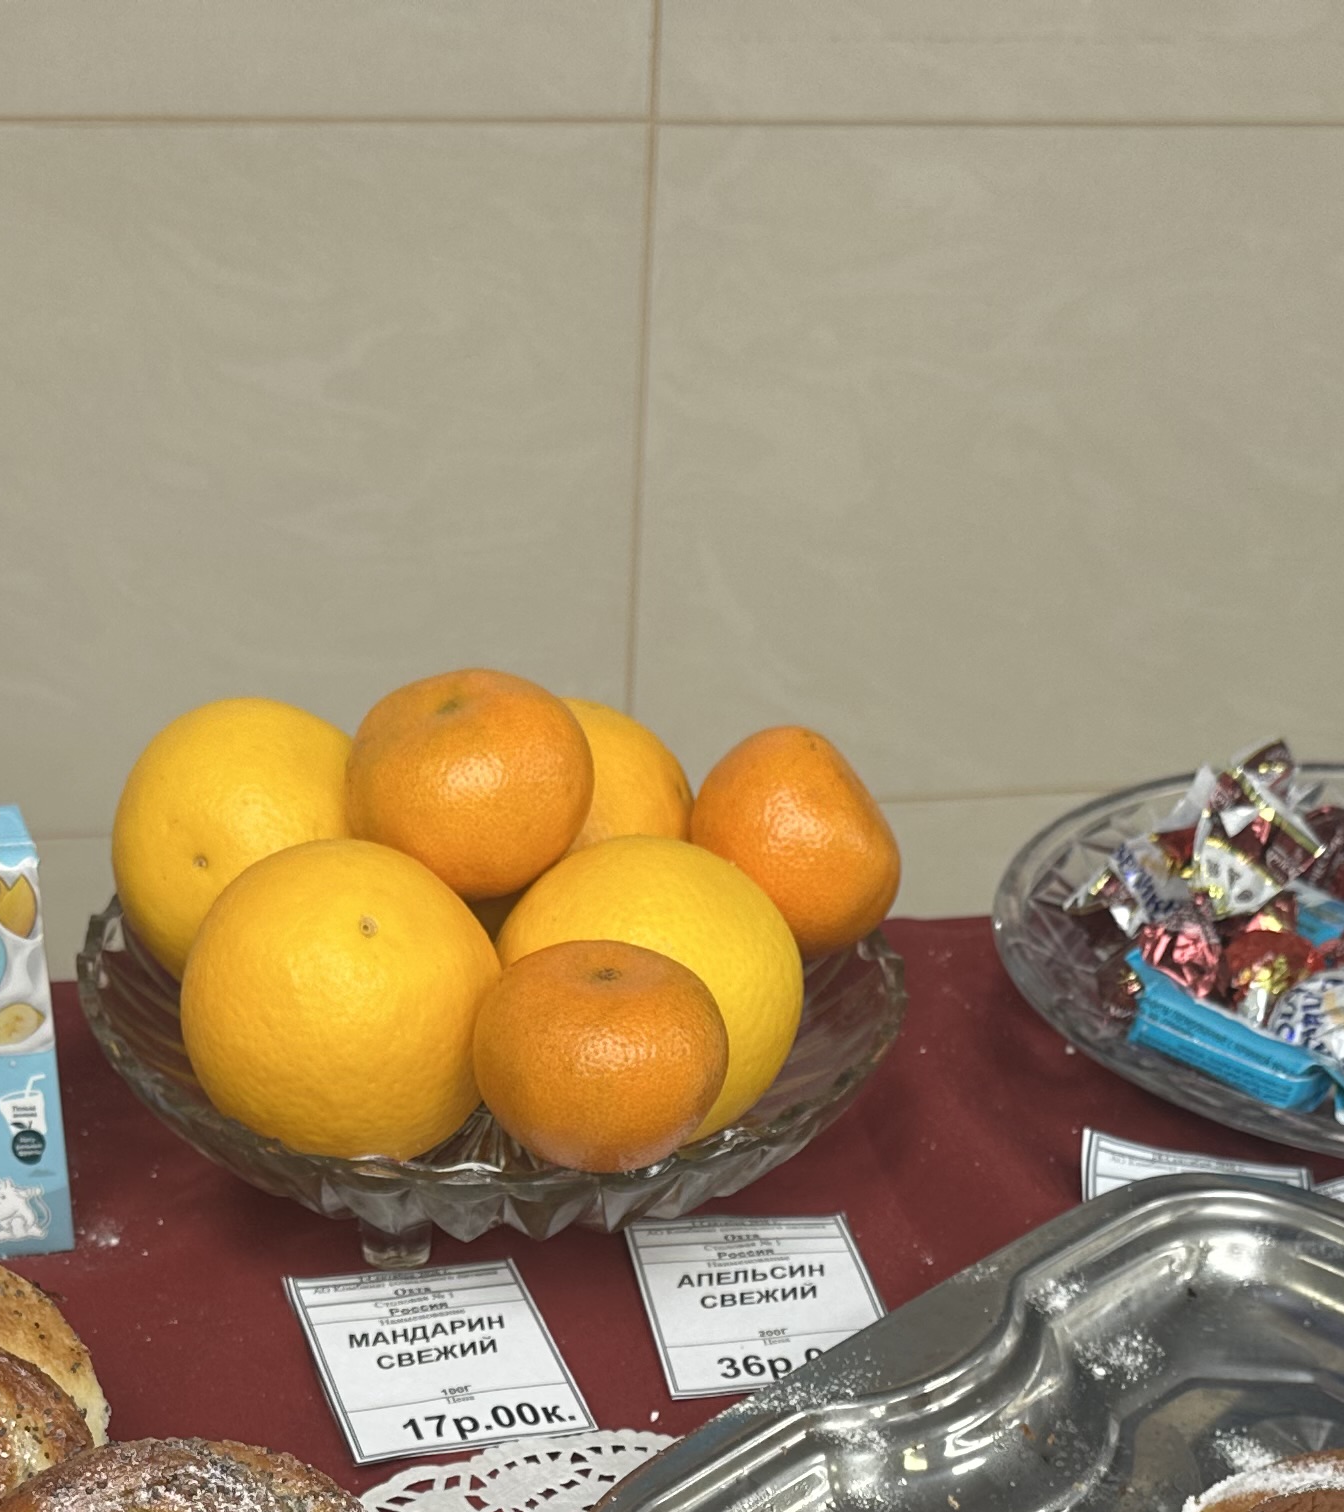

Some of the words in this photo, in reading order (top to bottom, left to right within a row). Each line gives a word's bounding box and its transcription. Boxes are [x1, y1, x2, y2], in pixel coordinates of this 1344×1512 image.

[716, 1248, 775, 1260] Россия
[676, 1263, 825, 1289] АПЕЛЬСИН
[388, 1301, 449, 1317] Россия
[700, 1282, 818, 1310] СВЕЖИЙ
[348, 1315, 506, 1349] МАНДАРИН
[376, 1336, 499, 1370] СВЕЖИЙ
[402, 1402, 577, 1441] 17р.00к.
